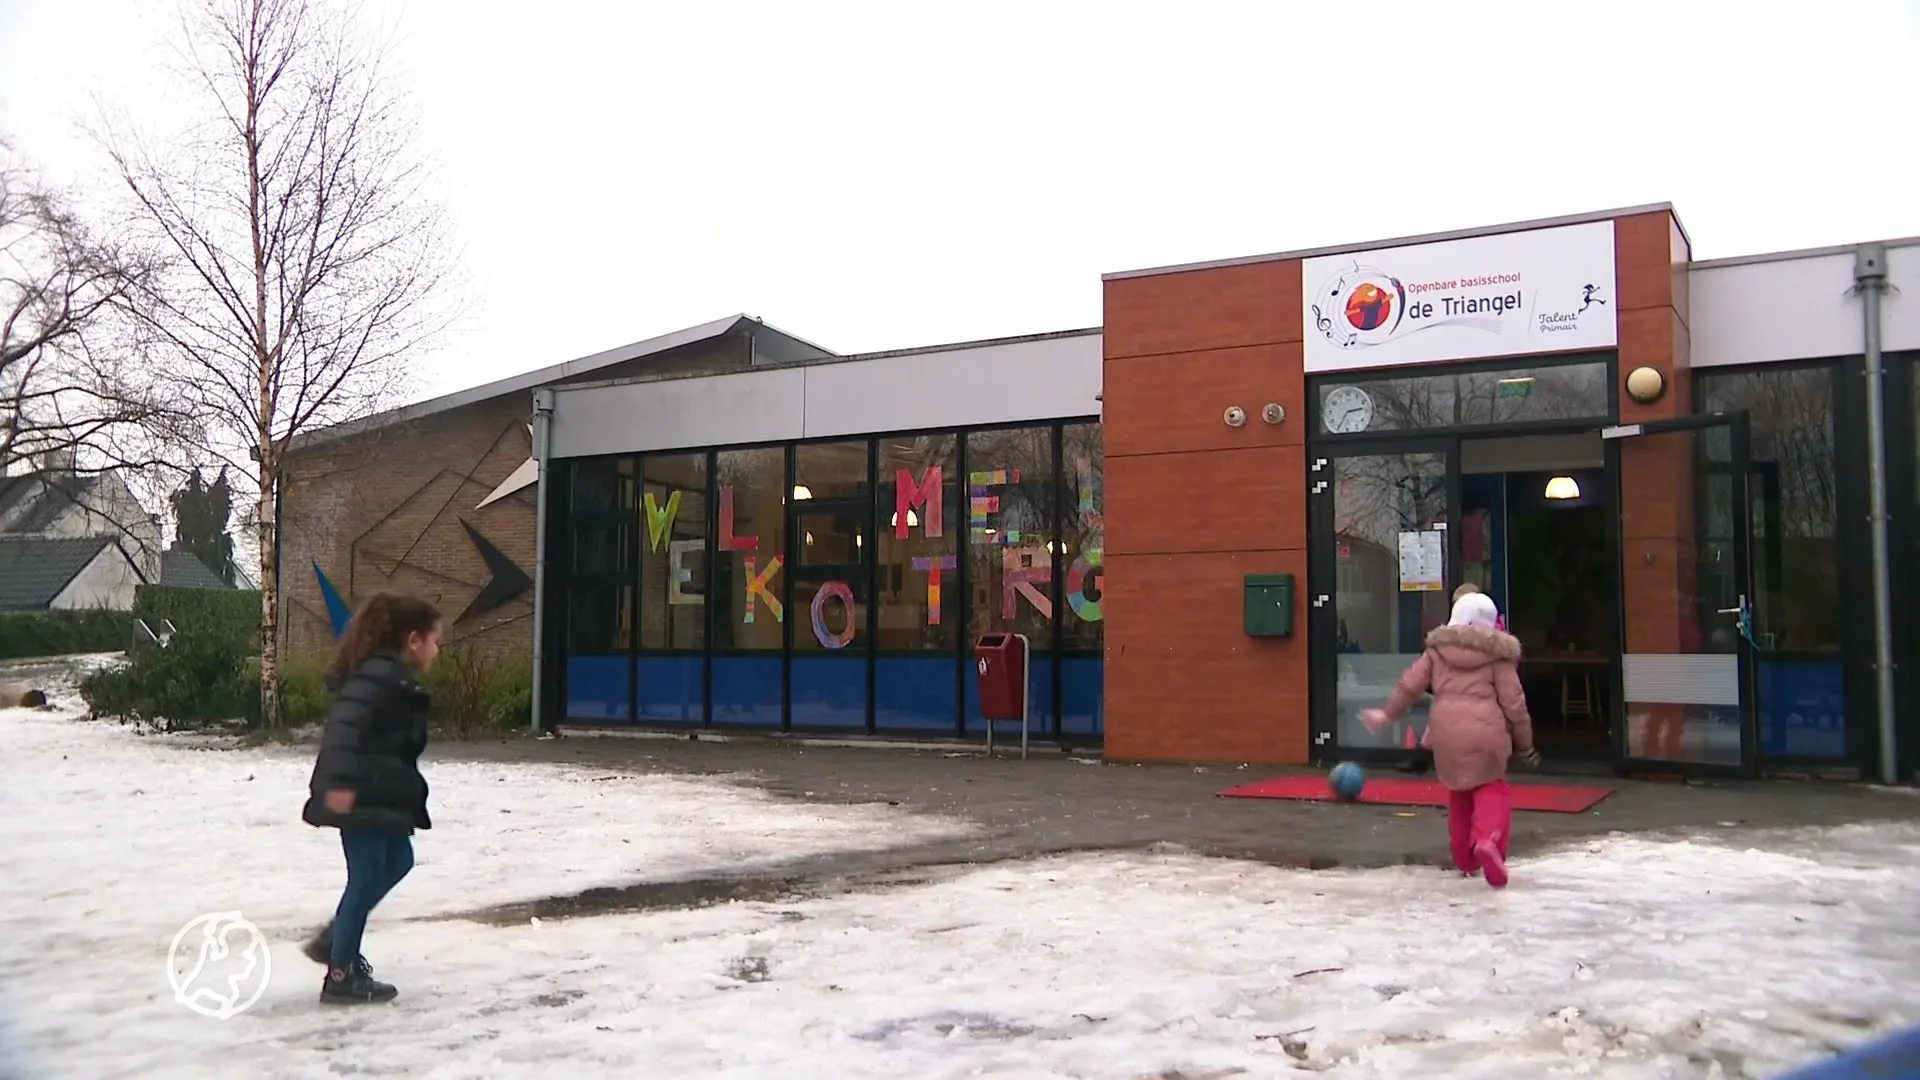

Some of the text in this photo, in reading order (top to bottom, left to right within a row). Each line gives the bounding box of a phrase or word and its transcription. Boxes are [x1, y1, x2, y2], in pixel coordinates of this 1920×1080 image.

[1408, 272, 1521, 294] Openbare basisschool
[1409, 290, 1522, 319] de Triangel
[1538, 312, 1578, 324] Talent
